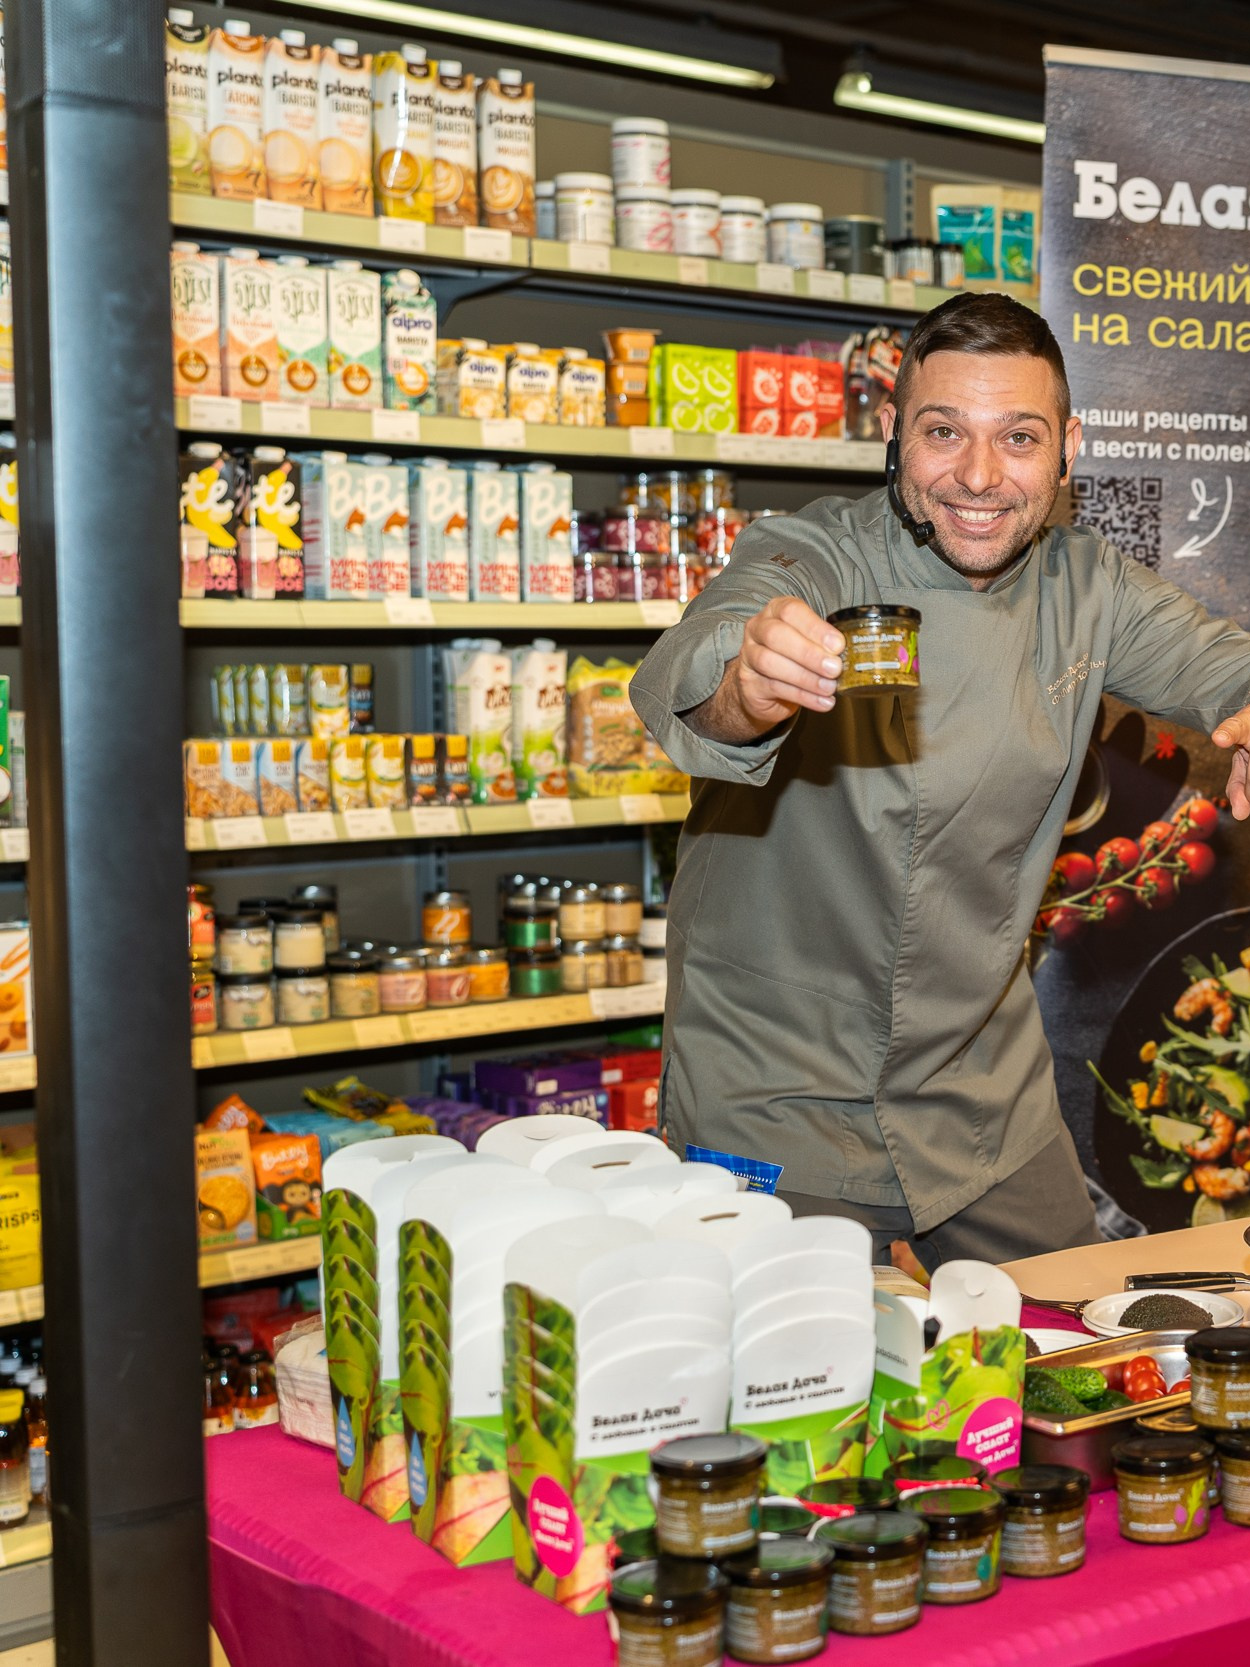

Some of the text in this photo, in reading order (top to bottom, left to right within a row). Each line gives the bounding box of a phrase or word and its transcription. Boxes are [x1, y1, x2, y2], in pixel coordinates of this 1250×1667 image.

[488, 110, 535, 126] planto
[392, 314, 432, 331] alpro
[1072, 311, 1130, 346] на
[469, 361, 498, 374] alpro
[518, 365, 549, 379] alpro
[571, 370, 598, 383] alpro
[1071, 407, 1248, 433] наши рецепты
[1092, 440, 1162, 459] вести
[1167, 443, 1181, 460] с
[746, 1374, 827, 1396] Белая Дача
[592, 1406, 681, 1427] Белая Дача
[966, 1416, 1014, 1446] Лучший
[974, 1432, 1011, 1454] салат
